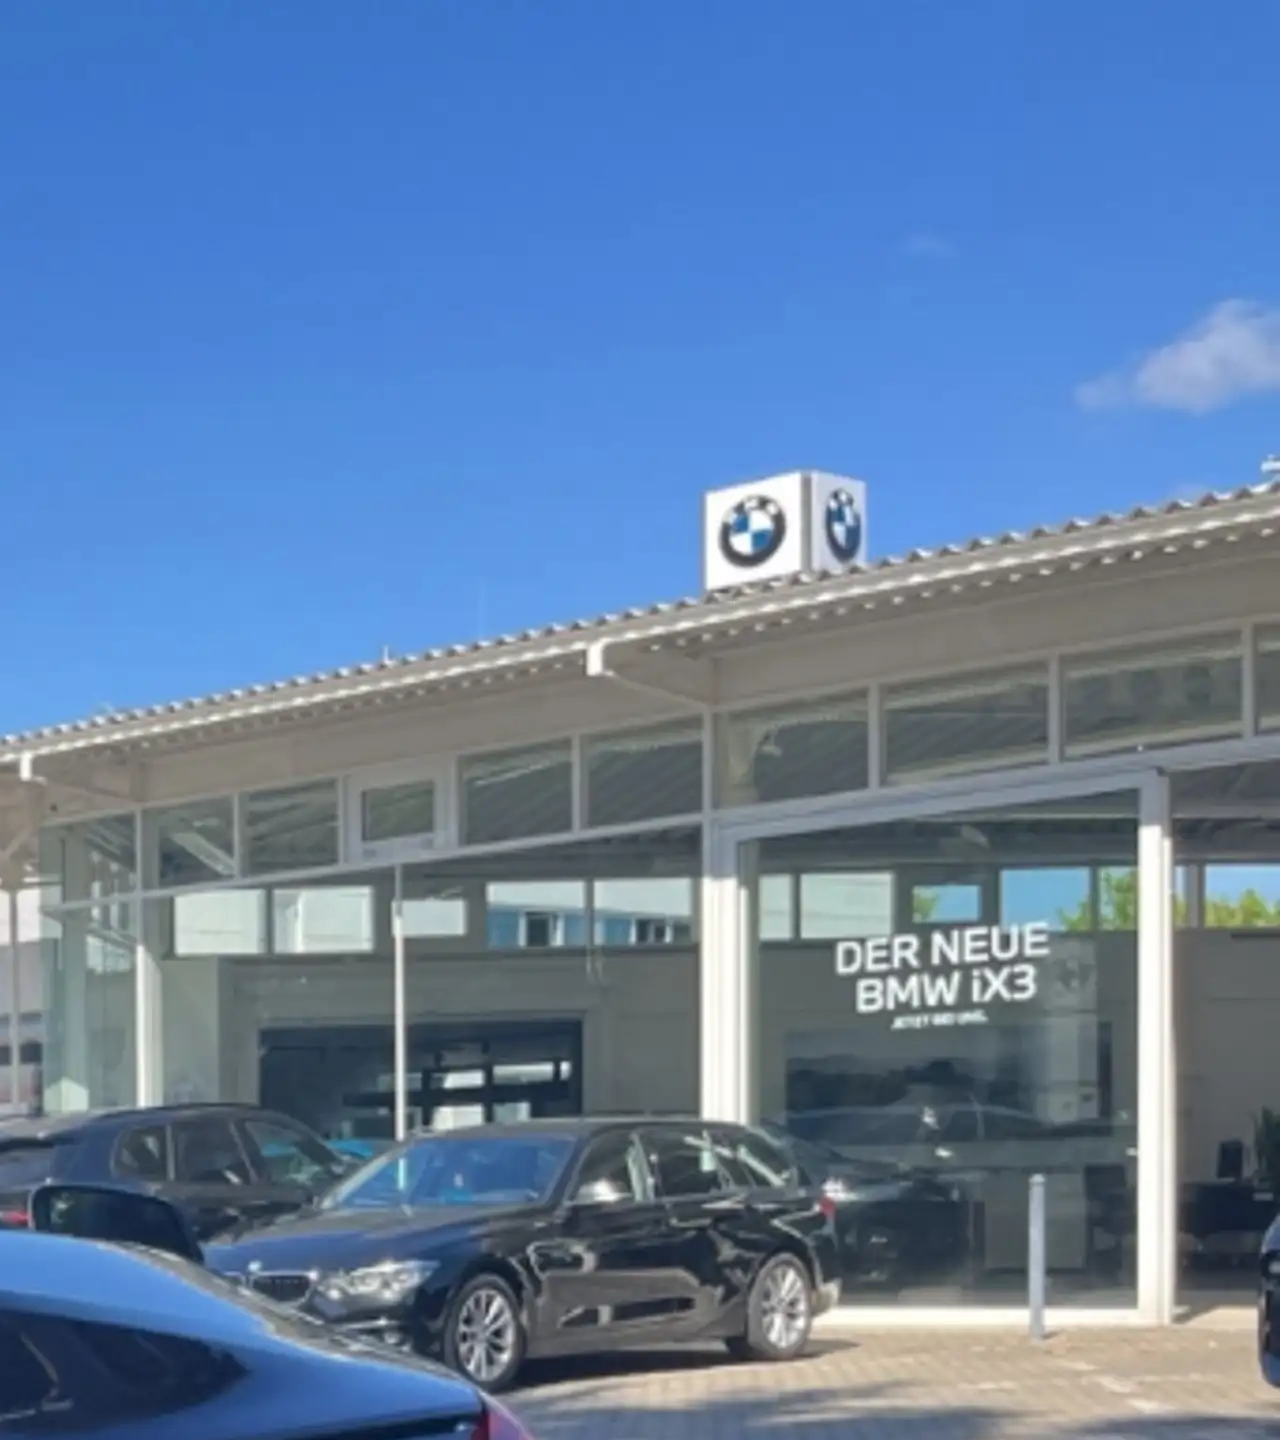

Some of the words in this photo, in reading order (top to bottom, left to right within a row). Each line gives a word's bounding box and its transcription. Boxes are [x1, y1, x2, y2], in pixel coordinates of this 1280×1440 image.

[835, 933, 921, 975] DER
[930, 922, 1050, 966] NEUE
[855, 971, 960, 1013] BMW
[970, 964, 1037, 1003] iX3
